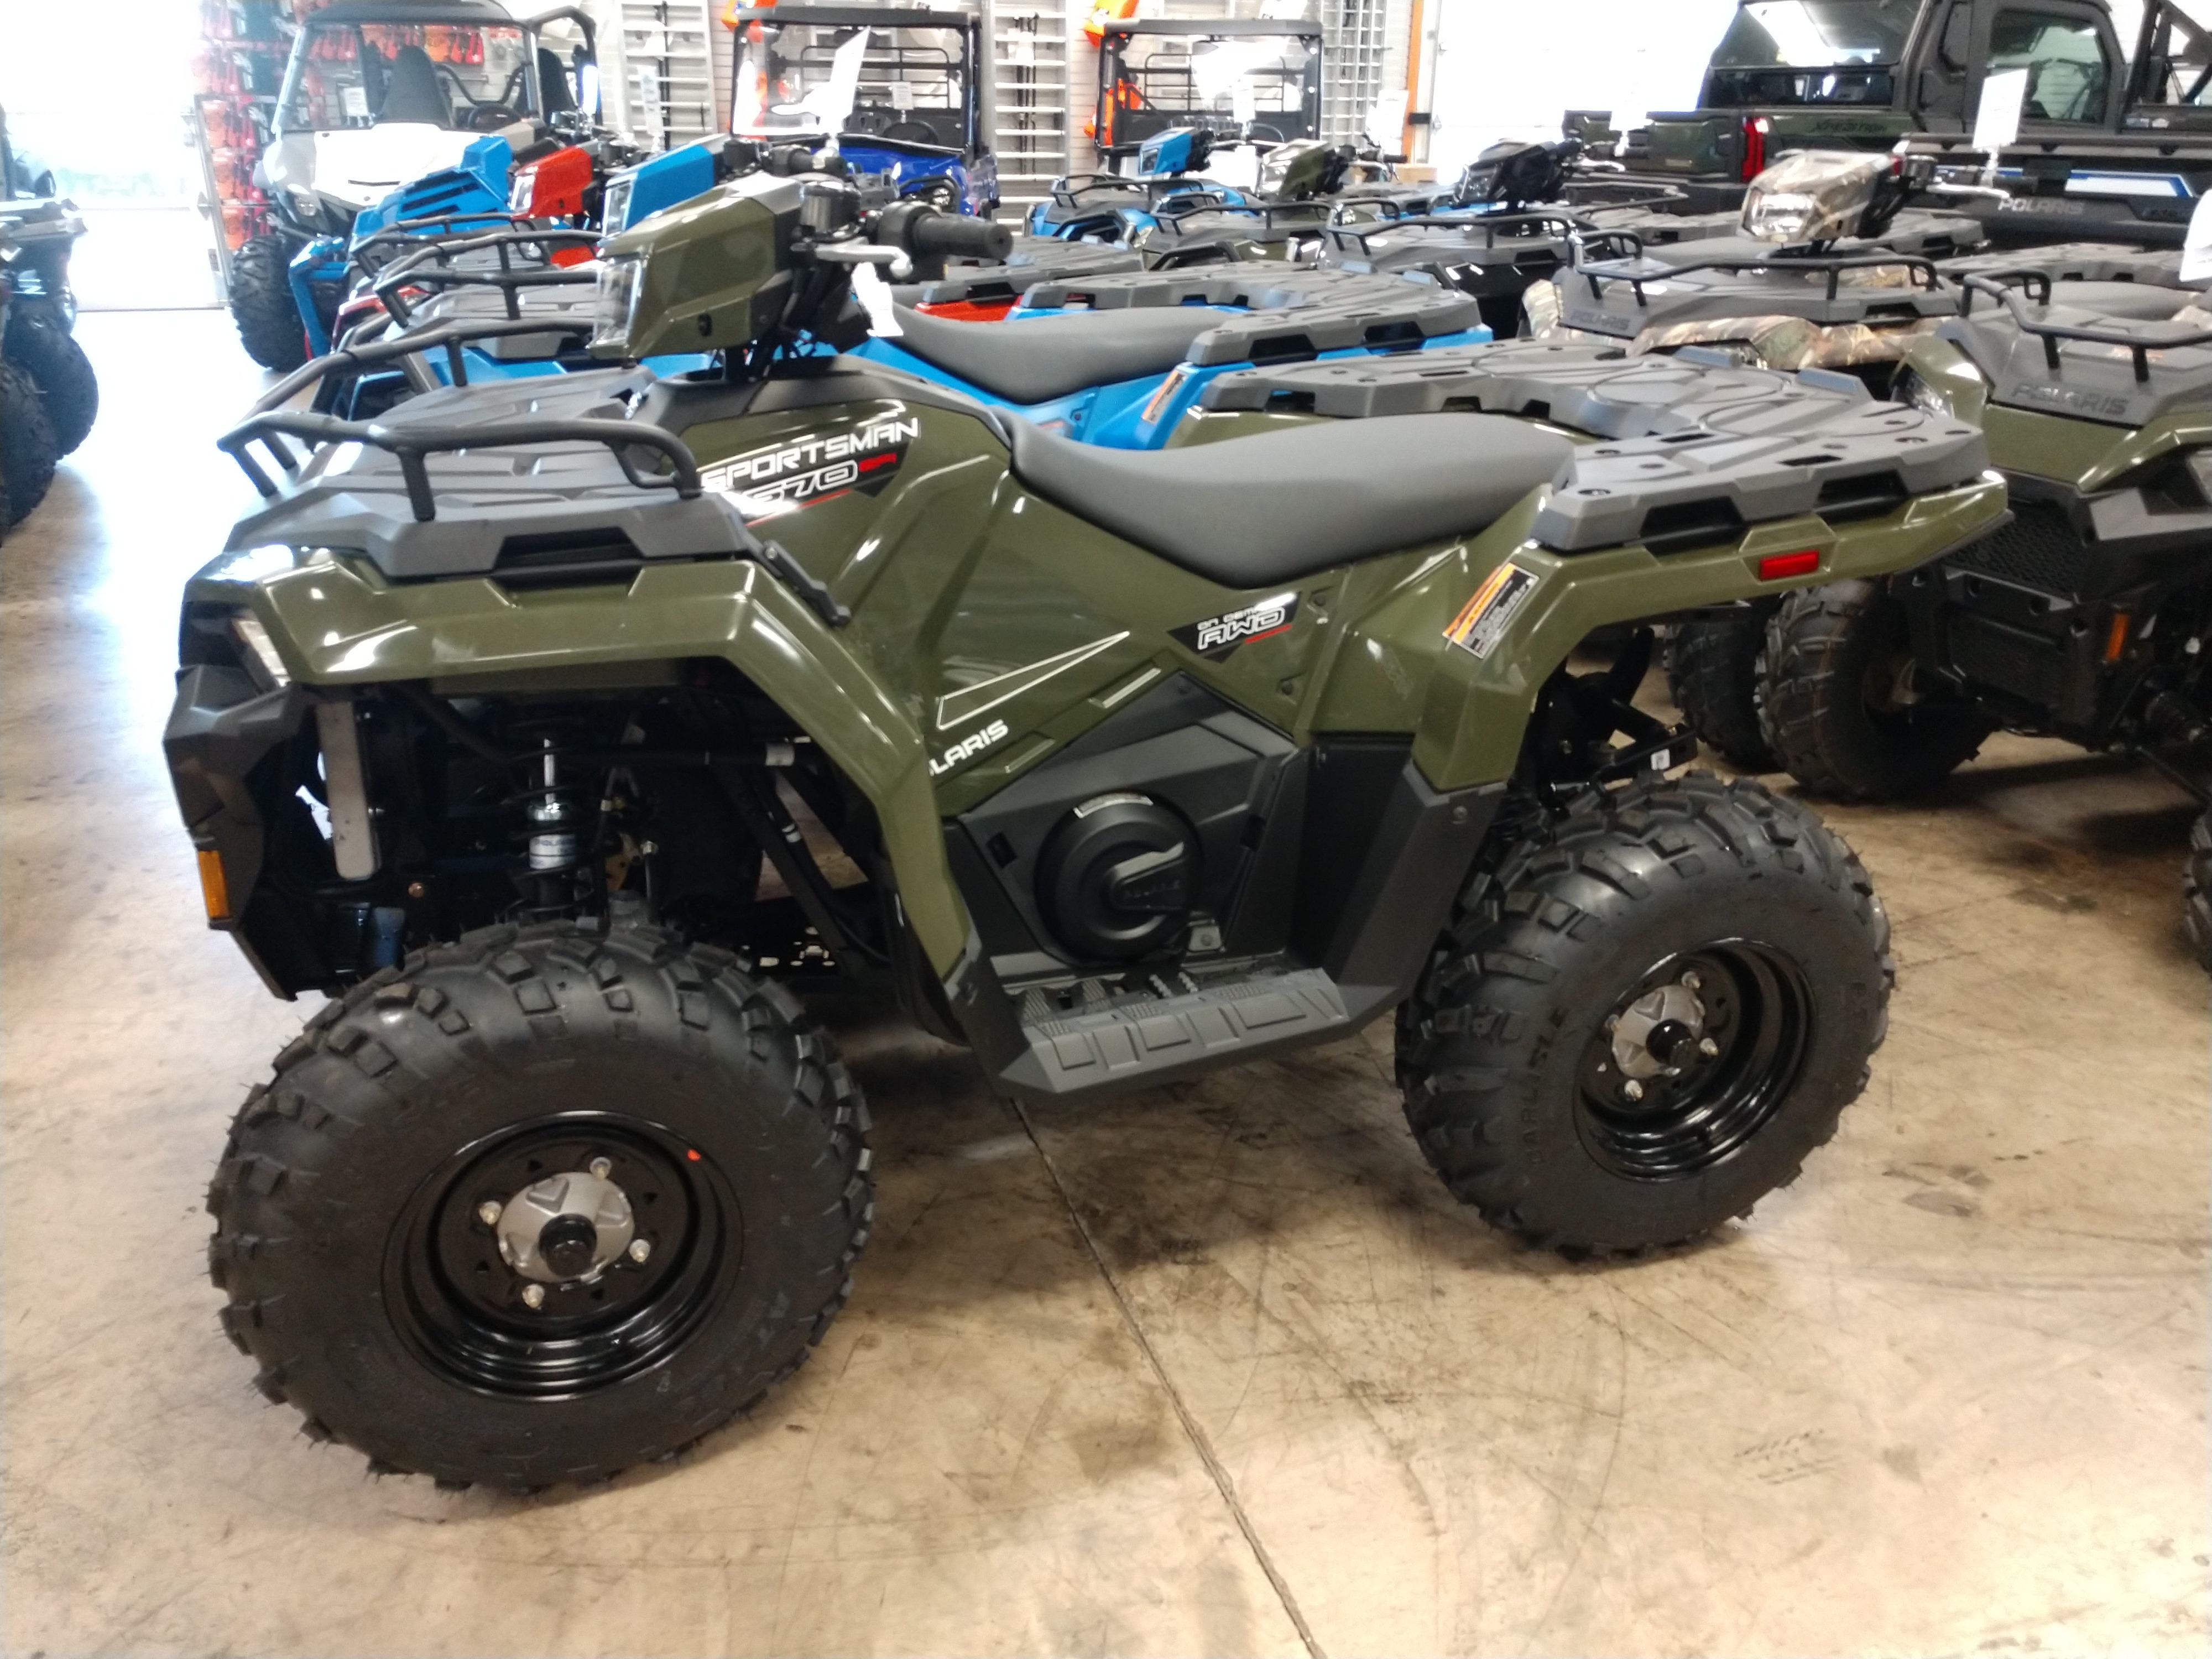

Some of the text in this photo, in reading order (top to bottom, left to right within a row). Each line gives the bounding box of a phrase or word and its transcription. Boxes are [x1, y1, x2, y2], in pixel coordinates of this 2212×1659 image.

[1997, 195, 2085, 215] POLARIS
[701, 417, 921, 492] SPORTSMAN
[1197, 607, 1286, 650] AWD
[928, 719, 1009, 776] LARIS
